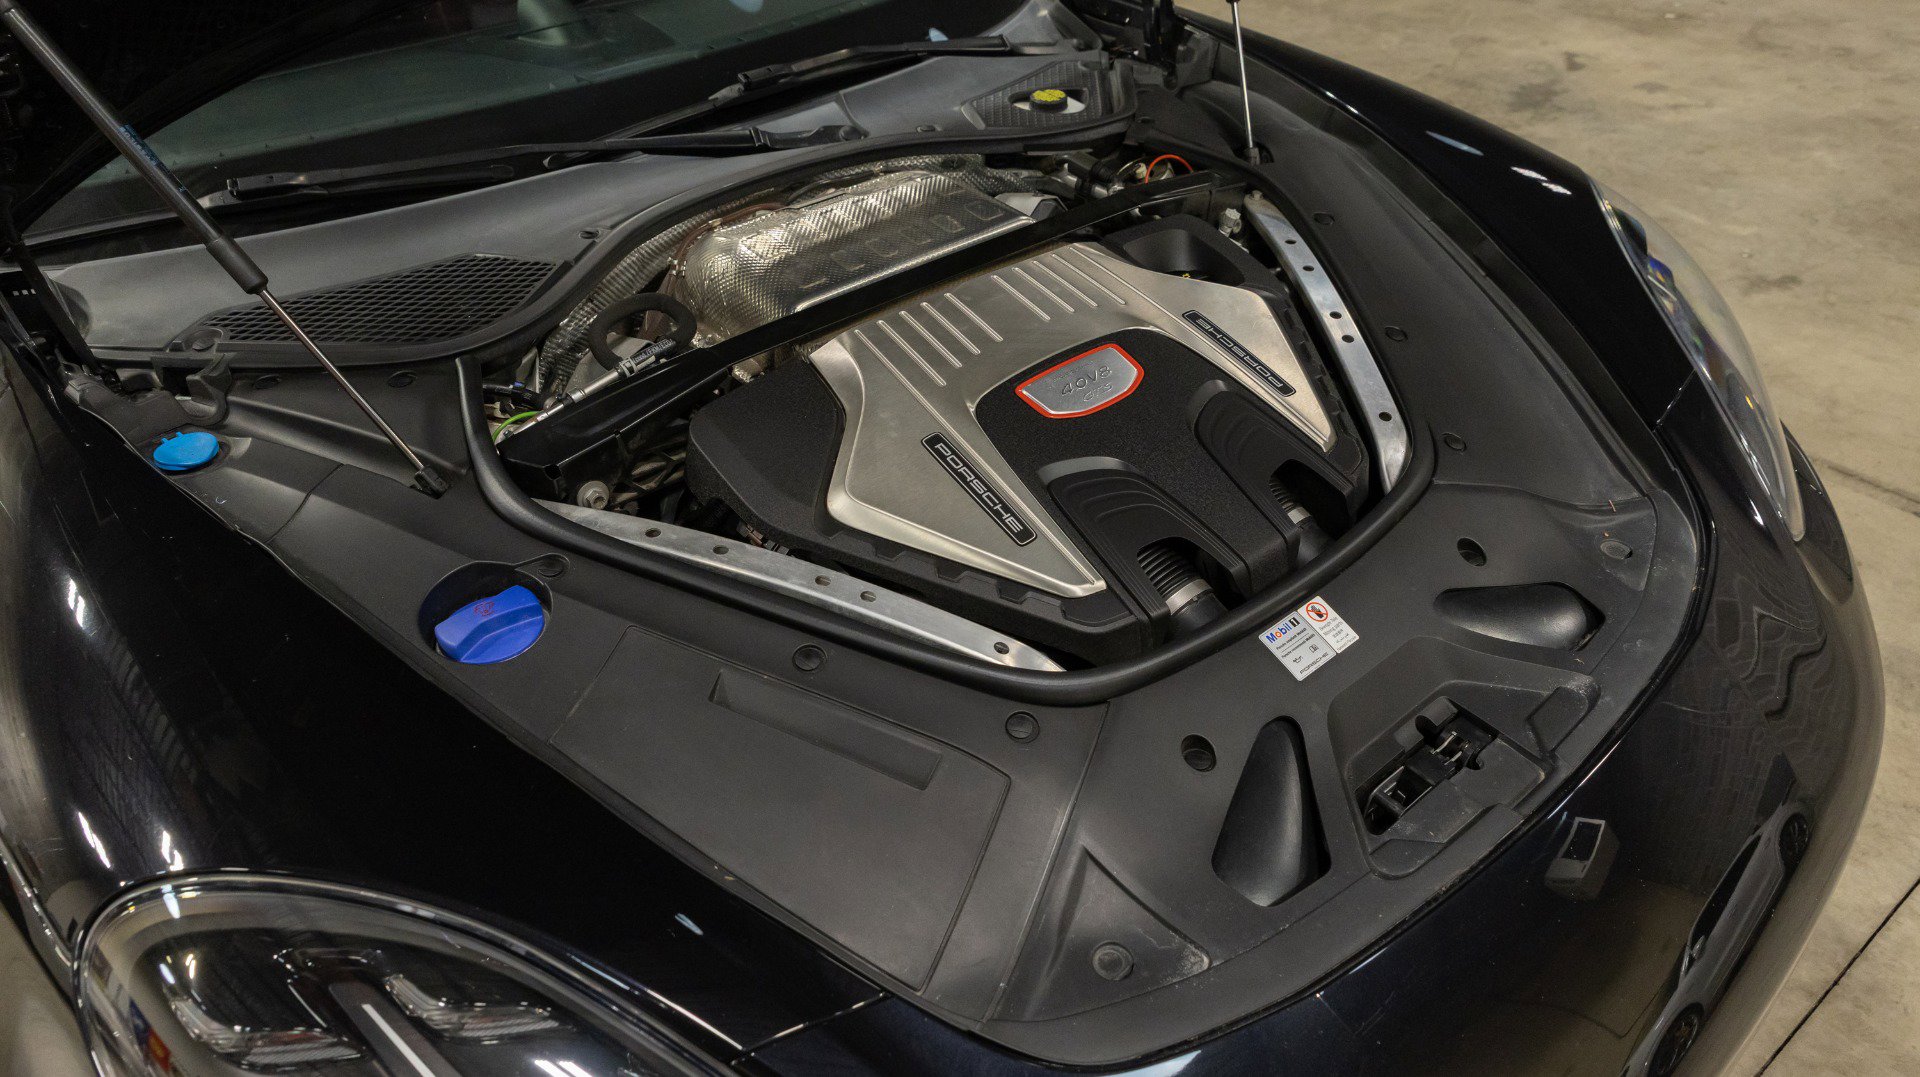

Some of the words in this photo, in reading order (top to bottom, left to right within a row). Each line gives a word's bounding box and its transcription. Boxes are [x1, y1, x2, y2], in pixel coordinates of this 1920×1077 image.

[1196, 319, 1283, 388] PORSCHE
[934, 442, 1023, 533] PORSCHE
[1265, 622, 1293, 644] Mobil
[1300, 652, 1328, 674] PORSCHE
